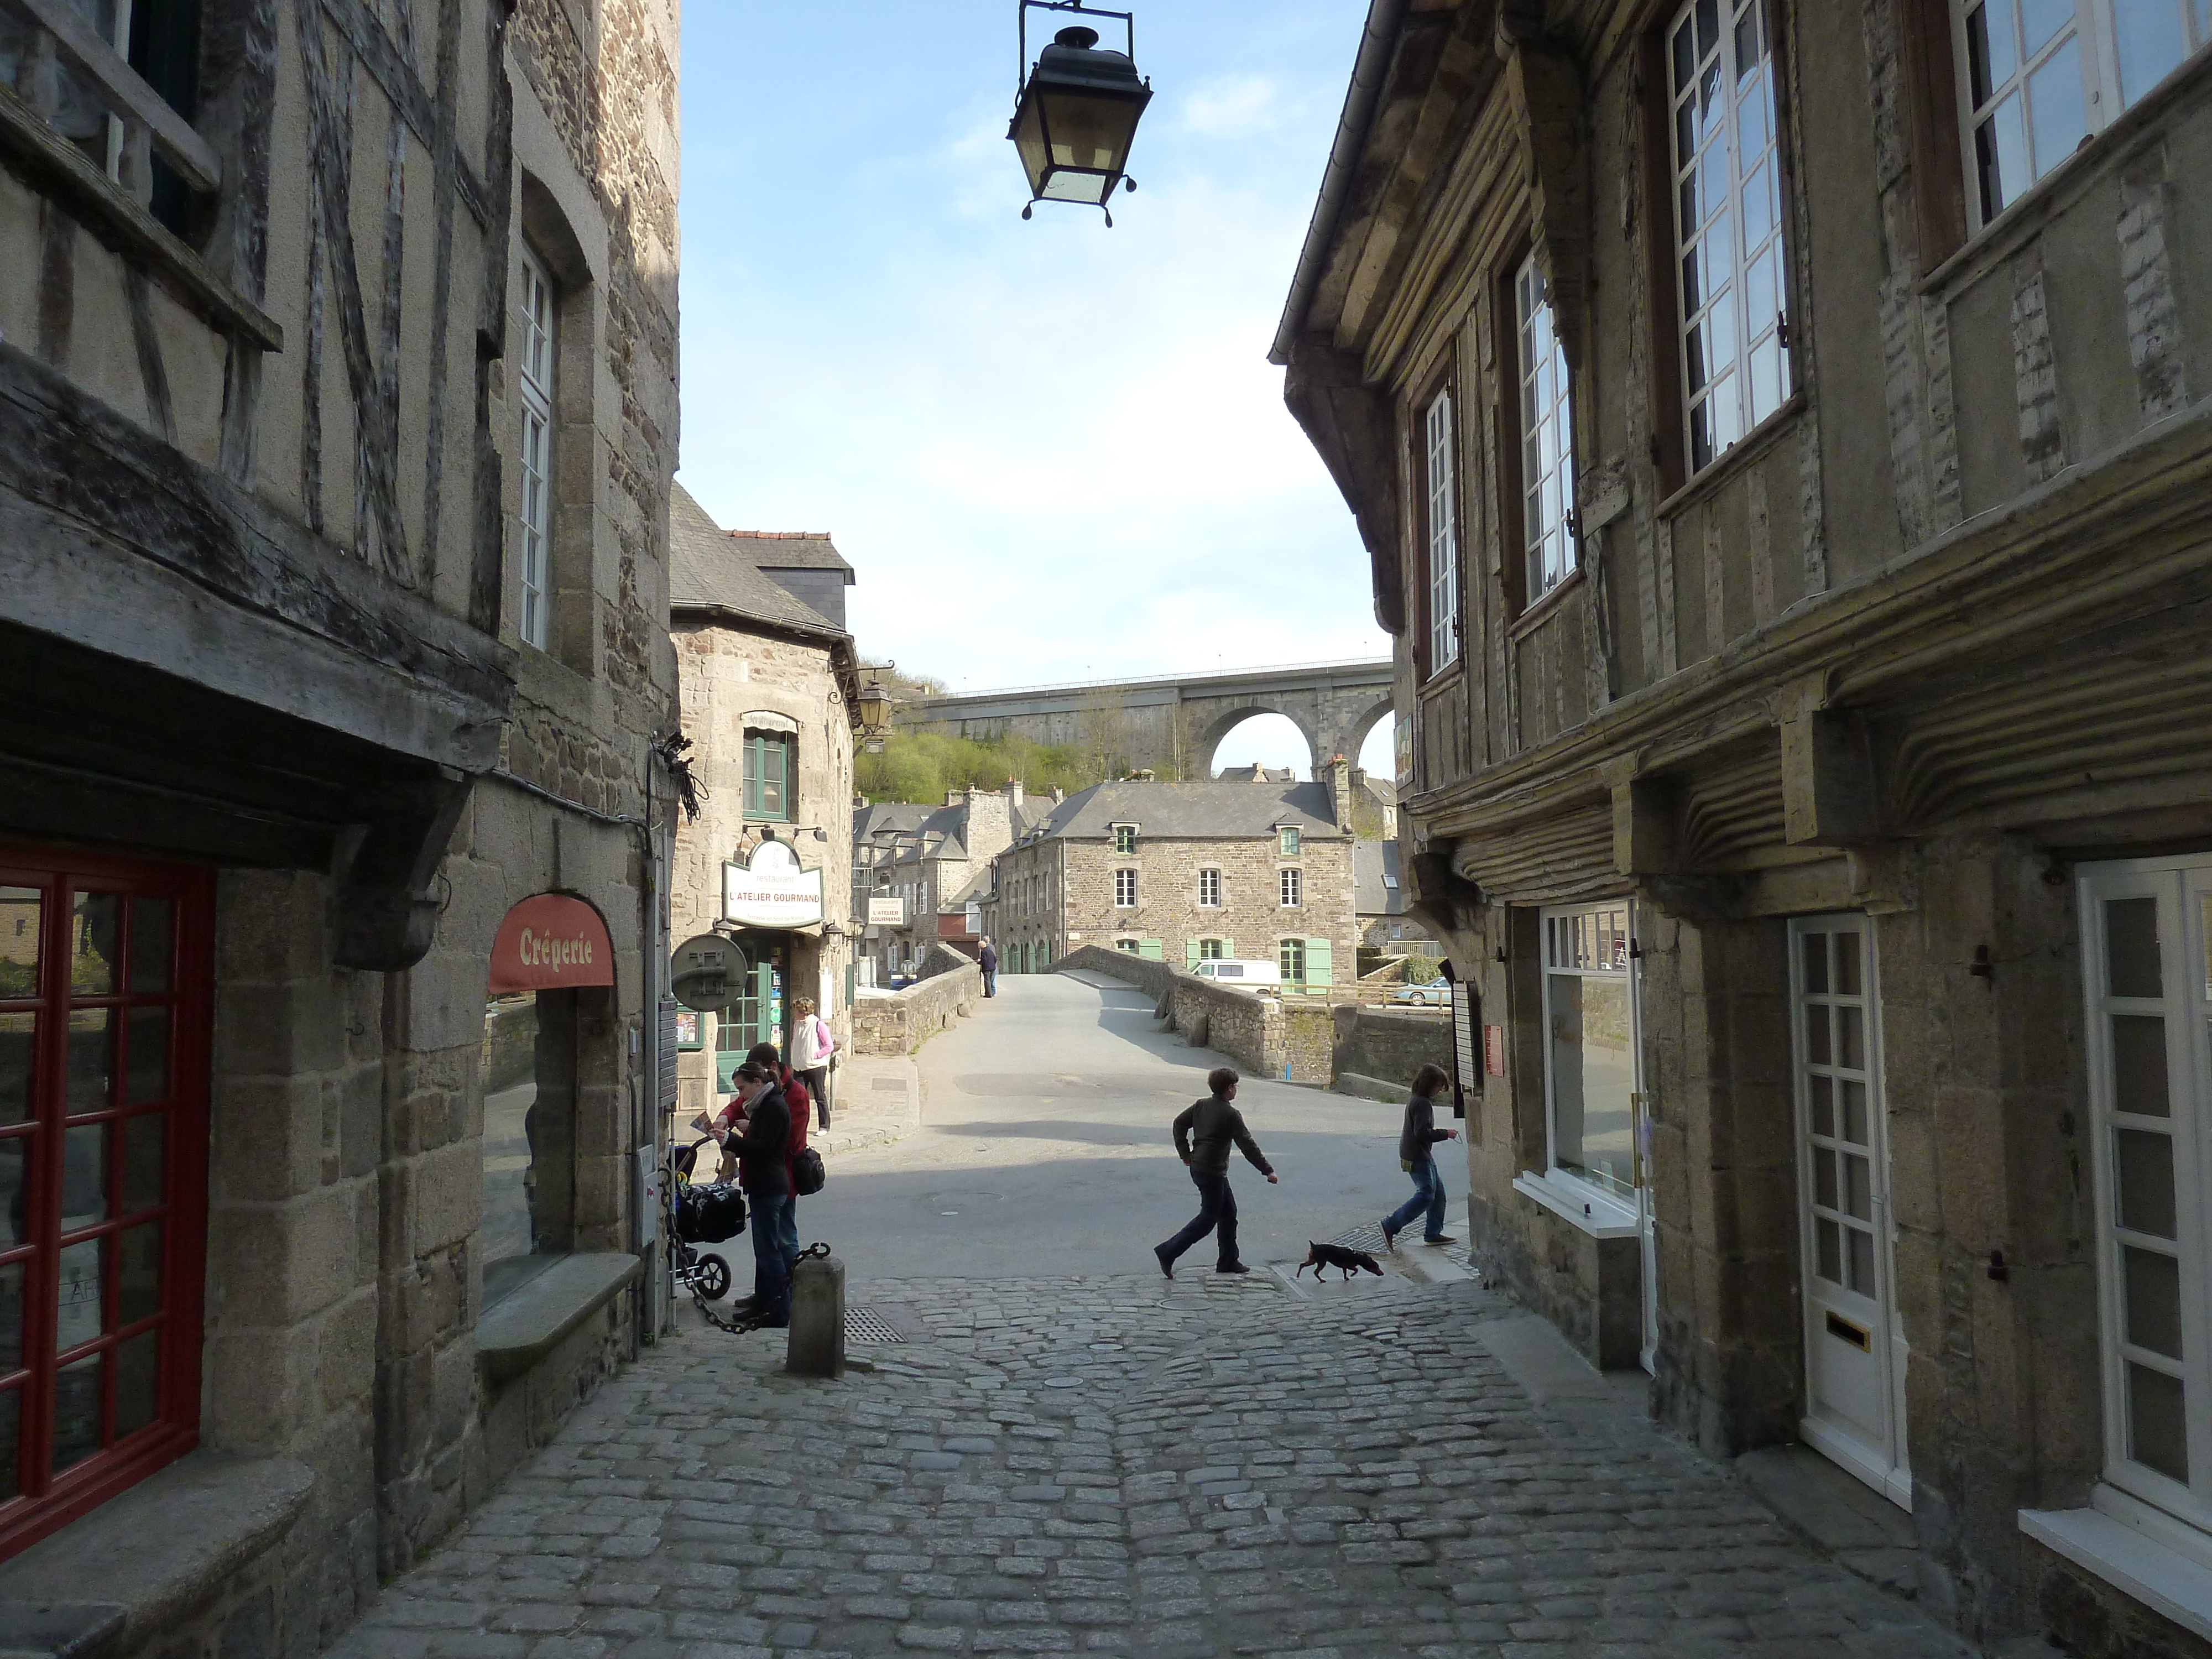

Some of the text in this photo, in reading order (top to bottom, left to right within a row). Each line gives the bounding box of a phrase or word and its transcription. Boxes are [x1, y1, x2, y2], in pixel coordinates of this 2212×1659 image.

[730, 892, 820, 902] L'ATELIER GOURMAND
[520, 927, 592, 973] Crêperie
